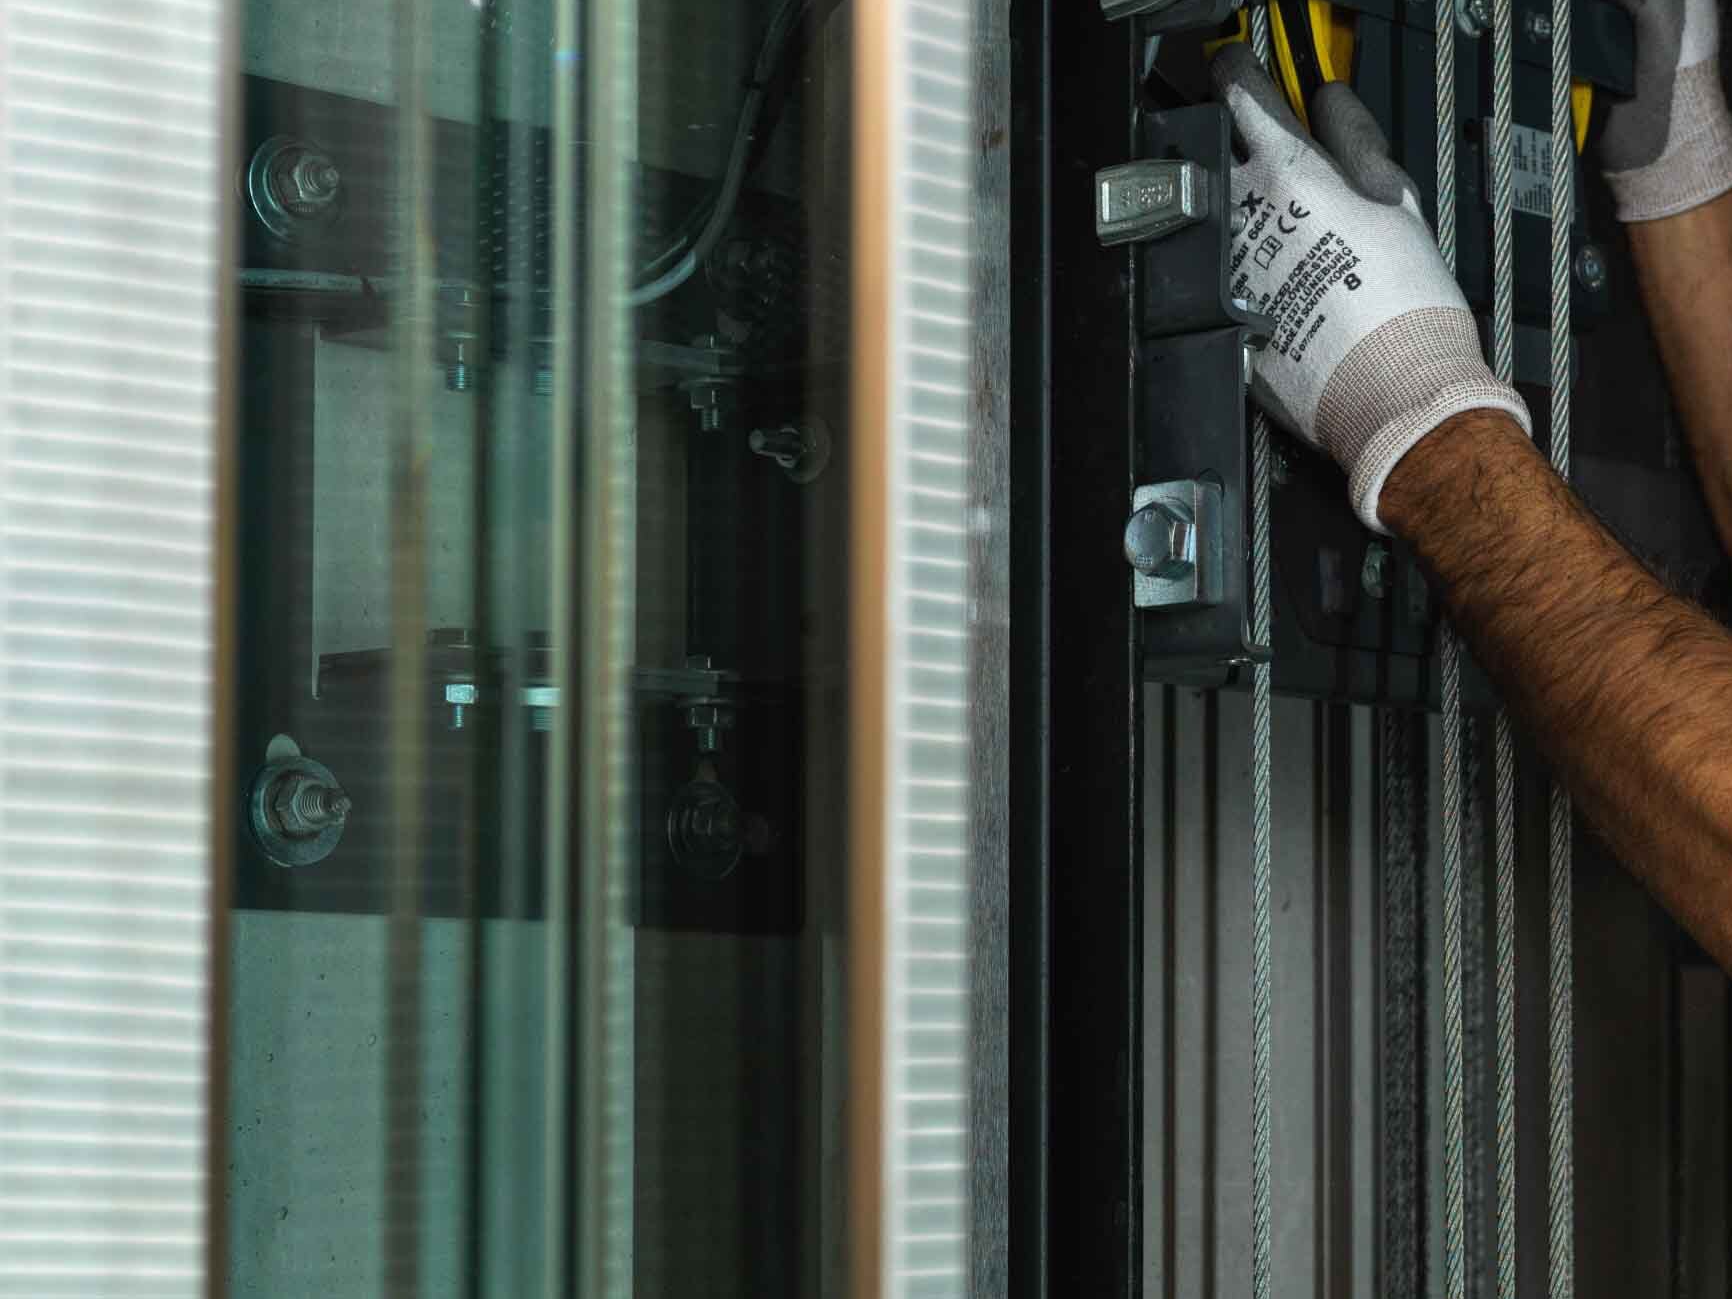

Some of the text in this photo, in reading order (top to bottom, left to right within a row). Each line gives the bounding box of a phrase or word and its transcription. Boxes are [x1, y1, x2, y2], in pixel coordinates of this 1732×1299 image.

[1248, 202, 1276, 240] 6641
[1306, 229, 1337, 262] uvex
[1343, 272, 1362, 291] 8
[1280, 255, 1361, 356] MADE IN SOUTH KOREA
